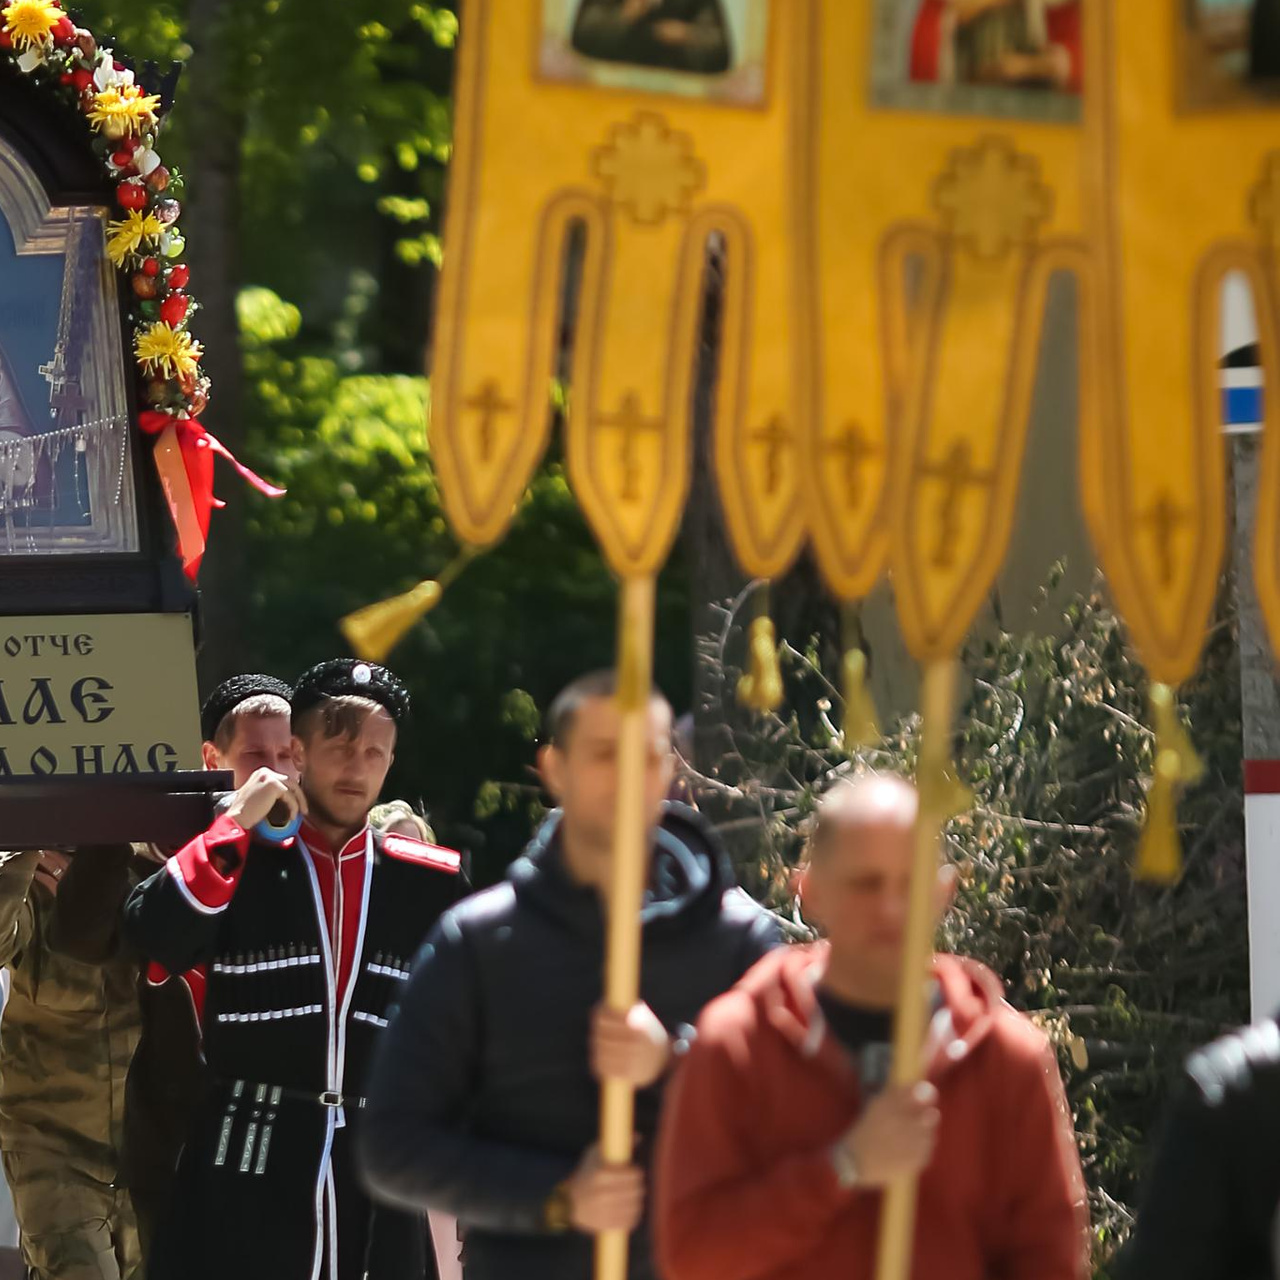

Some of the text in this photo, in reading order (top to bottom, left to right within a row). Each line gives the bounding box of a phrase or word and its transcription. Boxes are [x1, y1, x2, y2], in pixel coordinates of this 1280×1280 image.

[3, 633, 95, 658] ОТЧЕ
[29, 745, 59, 776] О
[71, 742, 179, 775] НАС
